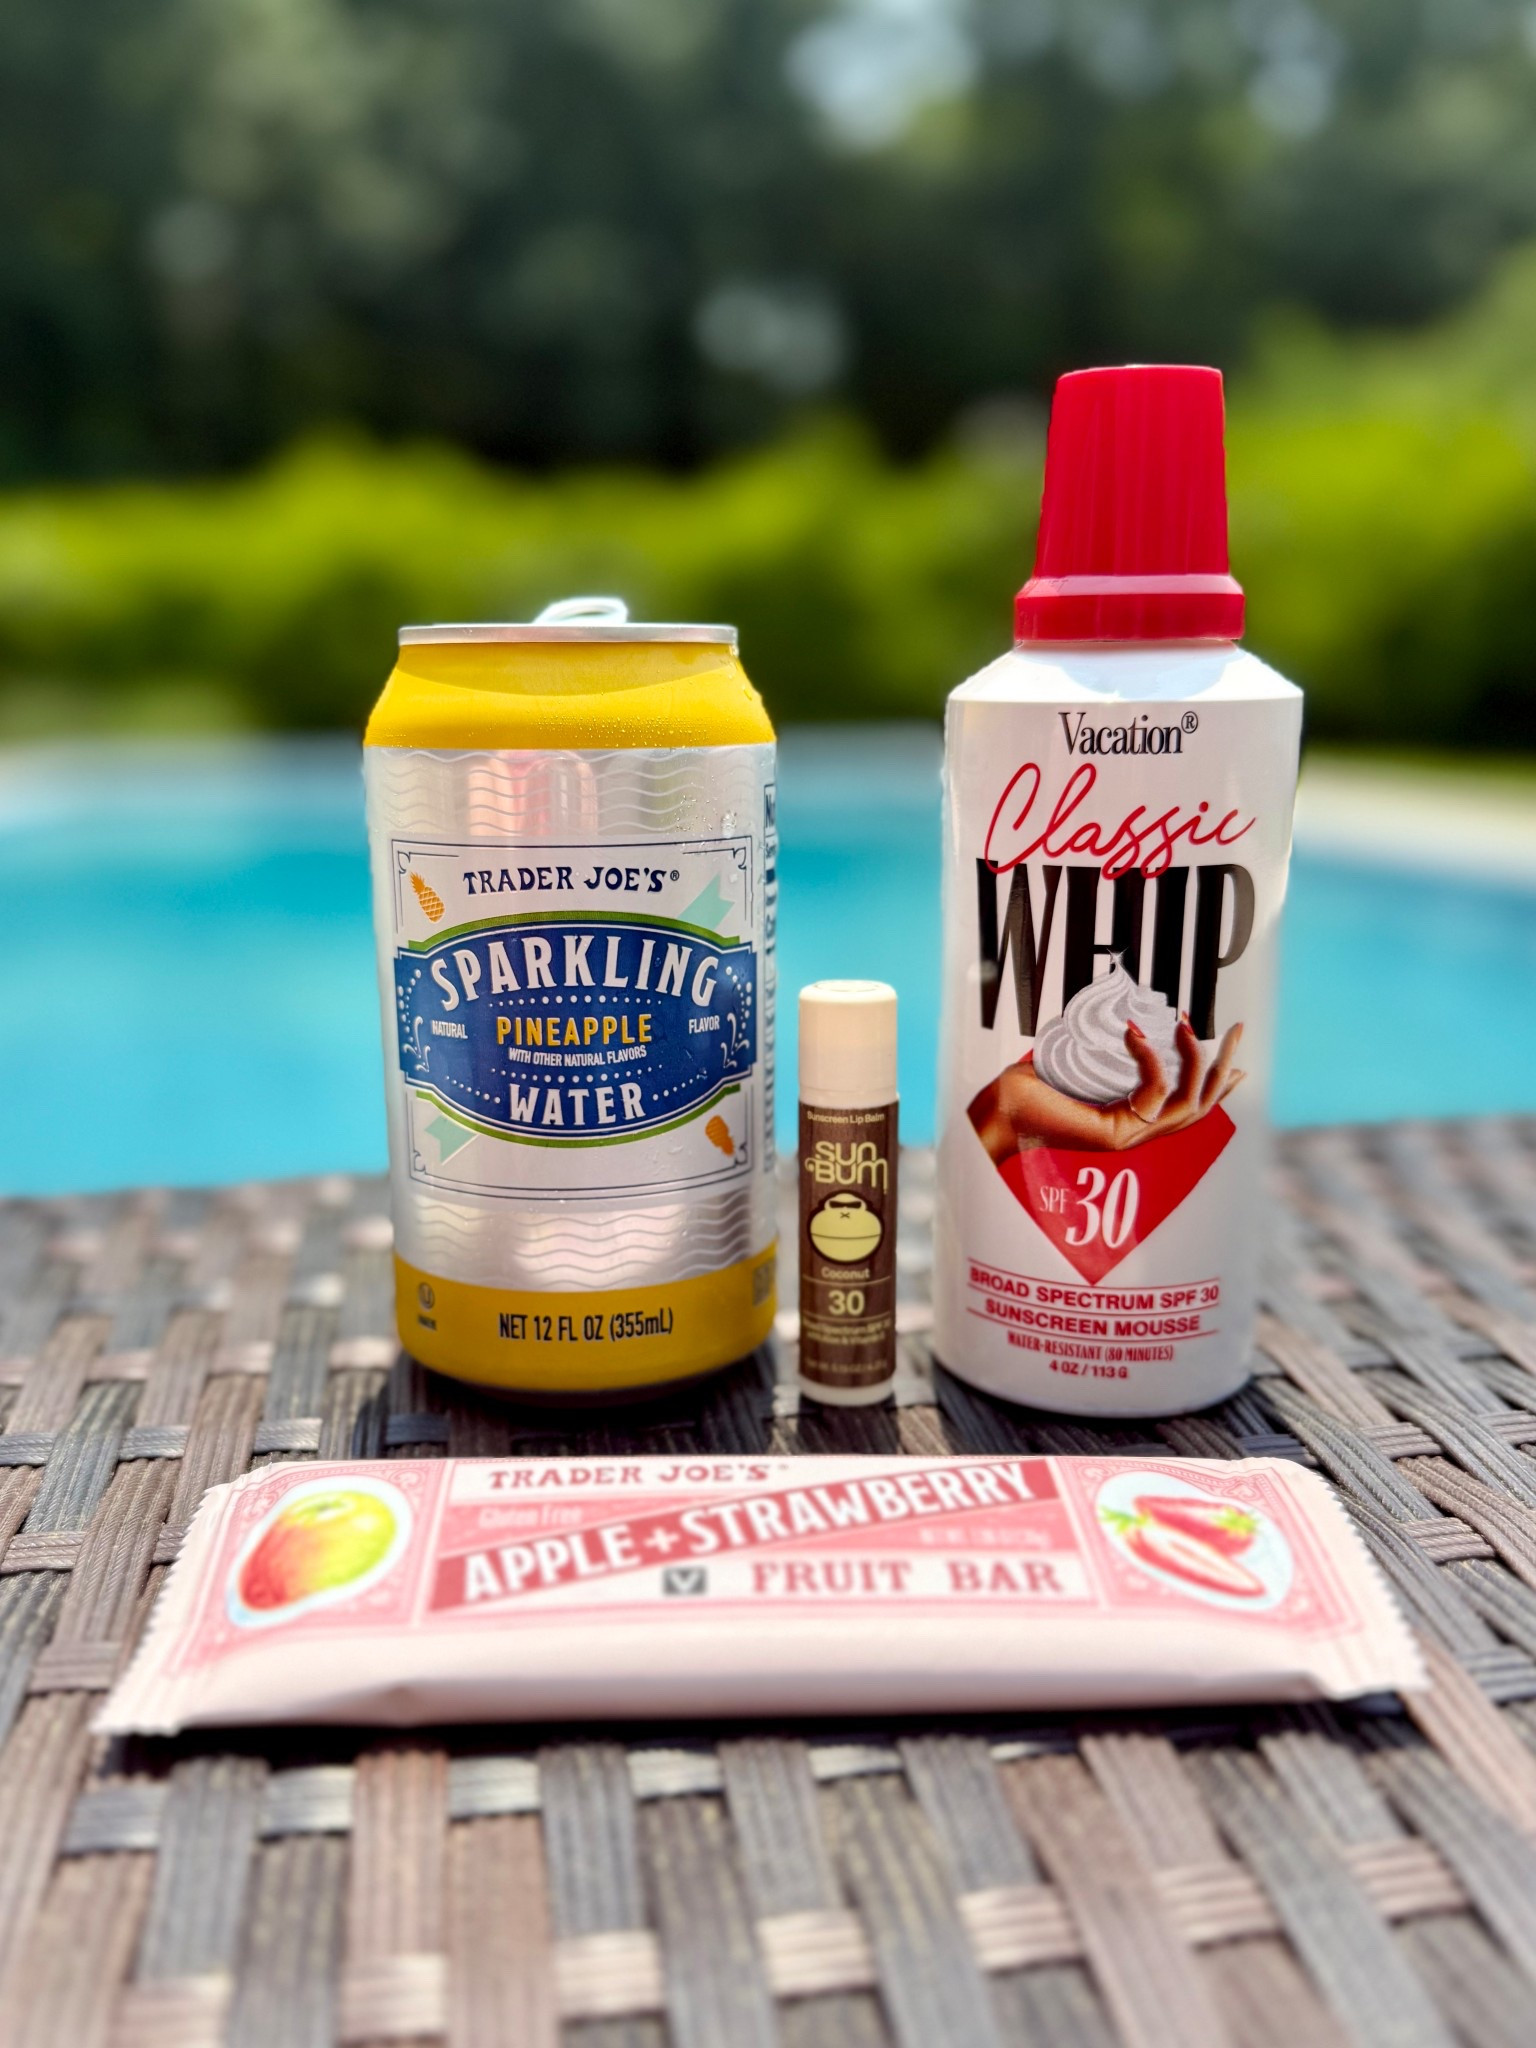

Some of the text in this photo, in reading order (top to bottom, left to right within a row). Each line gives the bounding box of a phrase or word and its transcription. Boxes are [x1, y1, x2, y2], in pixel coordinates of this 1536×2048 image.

[984, 762, 1256, 880] Classic
[463, 866, 574, 895] TRADER
[976, 857, 1256, 1041] WHIP
[431, 935, 719, 1011] SPARKLING
[432, 1020, 468, 1039] NATURAL
[497, 1014, 652, 1046] PINEAPPLE
[689, 1015, 720, 1034] FLAVOR
[509, 1045, 647, 1067] WITH OTHER NATURAL FLAVORS
[509, 1082, 646, 1126] WATER
[807, 1111, 885, 1125] Sunscreen Lip Balm
[1039, 1167, 1140, 1248] SPF 30
[821, 1267, 870, 1279] Coconut
[969, 1265, 1219, 1310] BROAD SPECTRUM SPF 30
[828, 1290, 865, 1316] 30
[985, 1298, 1200, 1337] SUNSCREEN MOUSSE
[499, 1307, 673, 1342] NET 12 FL OZ (355mL)
[1007, 1330, 1174, 1363] WATER-RESISTANT (80 MINUTES)
[1049, 1361, 1058, 1372] 4
[1061, 1362, 1079, 1375] OZ
[1092, 1364, 1116, 1378] 113
[489, 1465, 644, 1489] TRADER
[464, 1524, 641, 1603] APPLE
[680, 1462, 1034, 1555] STRAWBERRY
[752, 1560, 1063, 1594] FRUIT BAR
